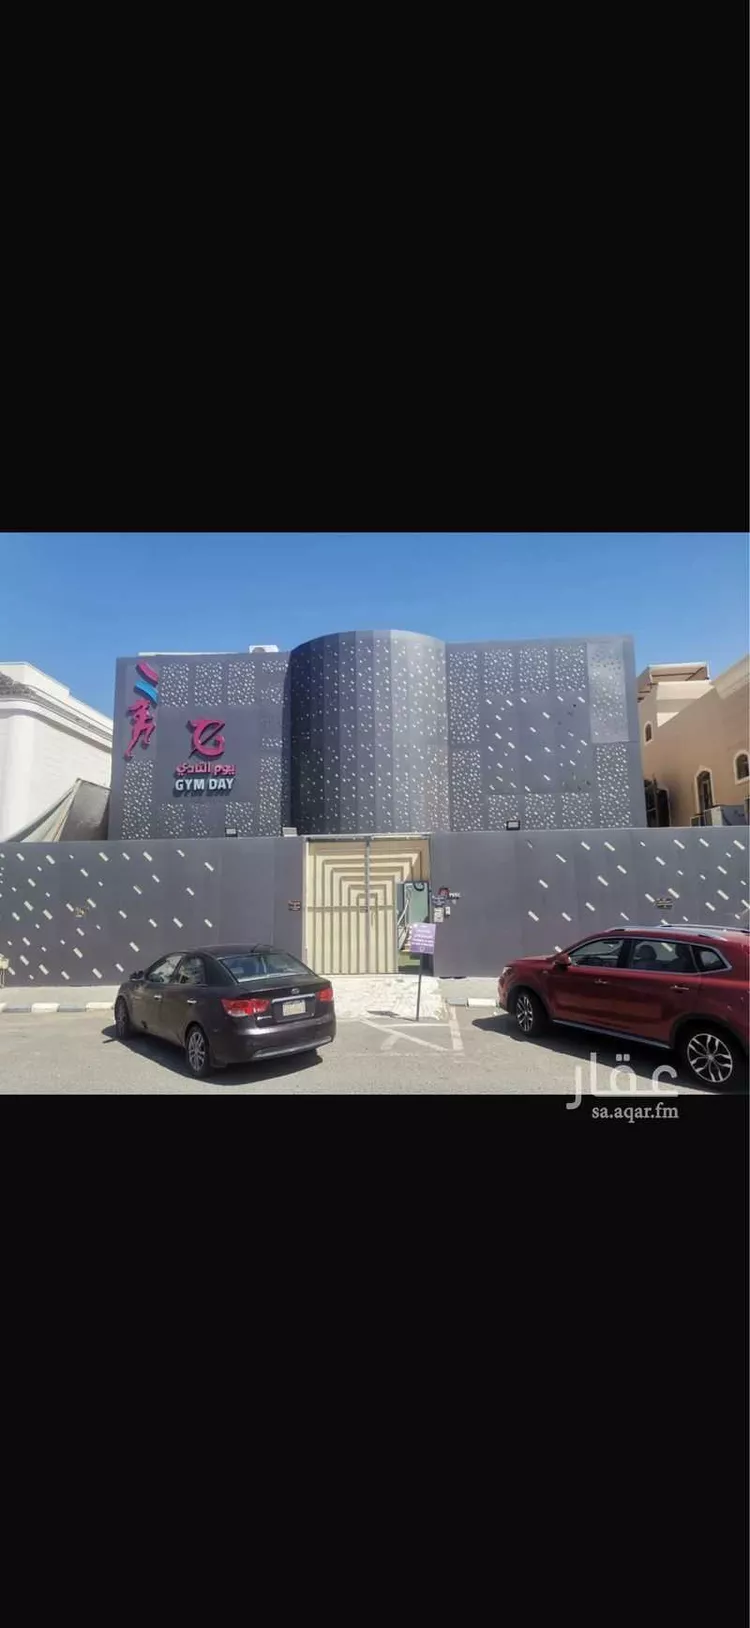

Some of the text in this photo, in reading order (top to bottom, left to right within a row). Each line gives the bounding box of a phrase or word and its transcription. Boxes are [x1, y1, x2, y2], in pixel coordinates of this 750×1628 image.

[176, 762, 236, 776] يوم النادي
[175, 778, 234, 791] GYM DAY
